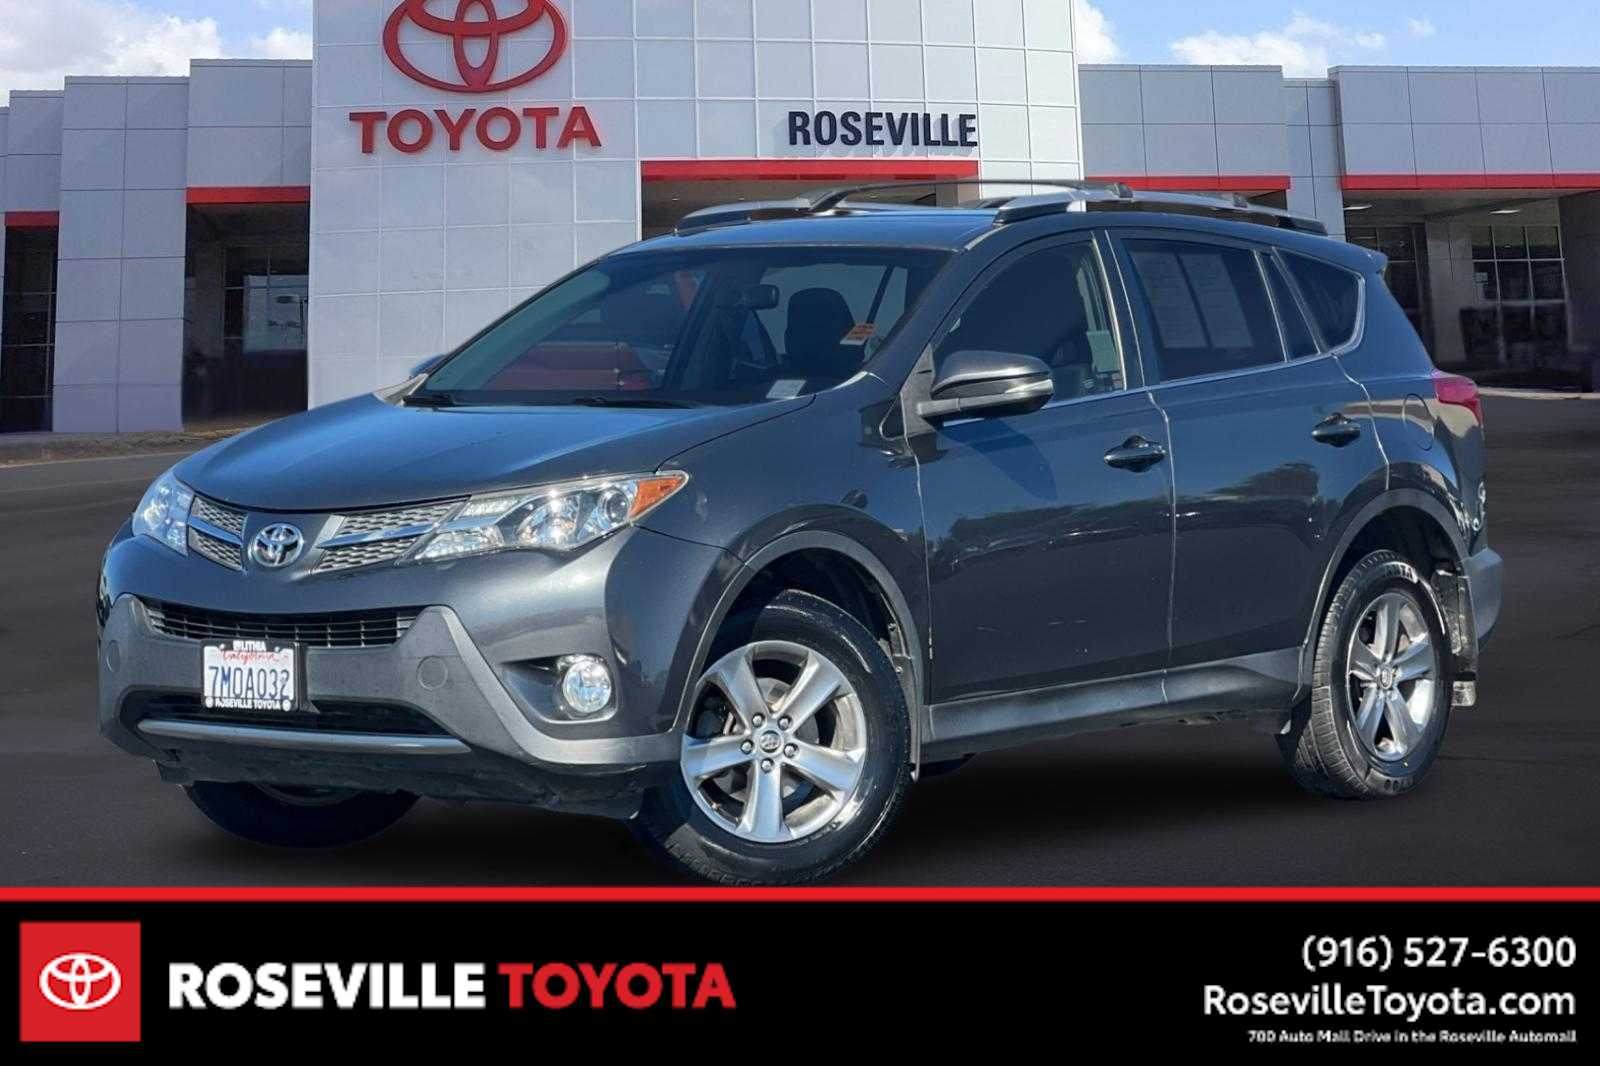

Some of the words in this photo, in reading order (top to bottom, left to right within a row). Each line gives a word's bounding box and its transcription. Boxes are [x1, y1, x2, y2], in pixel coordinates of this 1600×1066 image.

[350, 105, 602, 153] TOYOTA
[788, 111, 978, 147] ROSEVILLE
[215, 698, 252, 709] ROSEVILLE
[253, 699, 281, 710] TOYOTA
